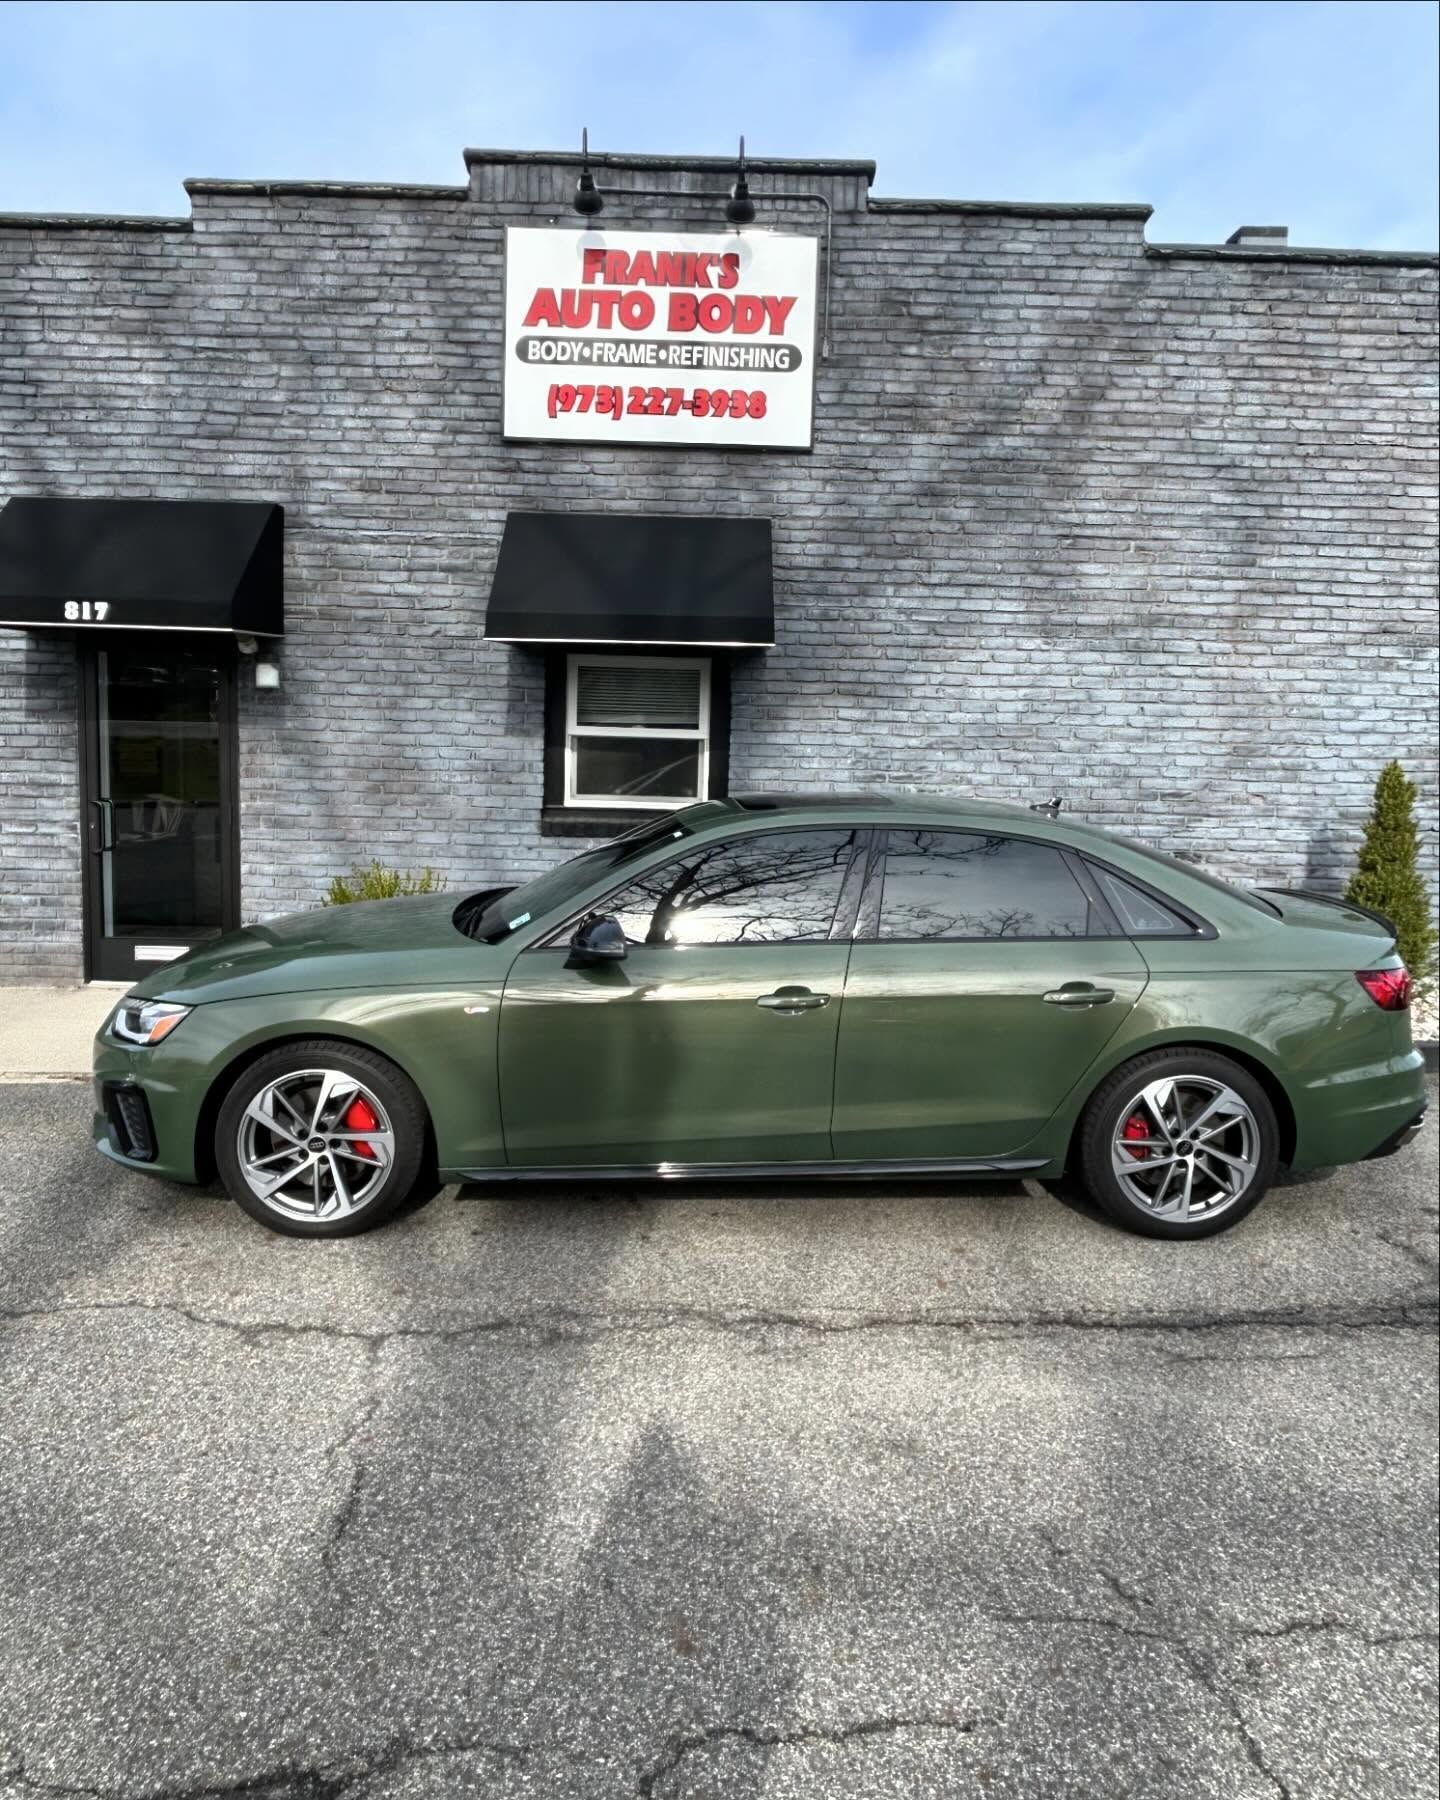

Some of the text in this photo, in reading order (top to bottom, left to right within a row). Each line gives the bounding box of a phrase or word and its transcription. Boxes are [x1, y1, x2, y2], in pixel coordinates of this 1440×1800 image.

[582, 248, 740, 289] FRANK'S
[521, 288, 799, 335] AUTO BODY
[527, 340, 791, 369] BODY FRAME REFINISHING
[547, 383, 768, 421] (973) 227-3938
[64, 601, 110, 621] 817
